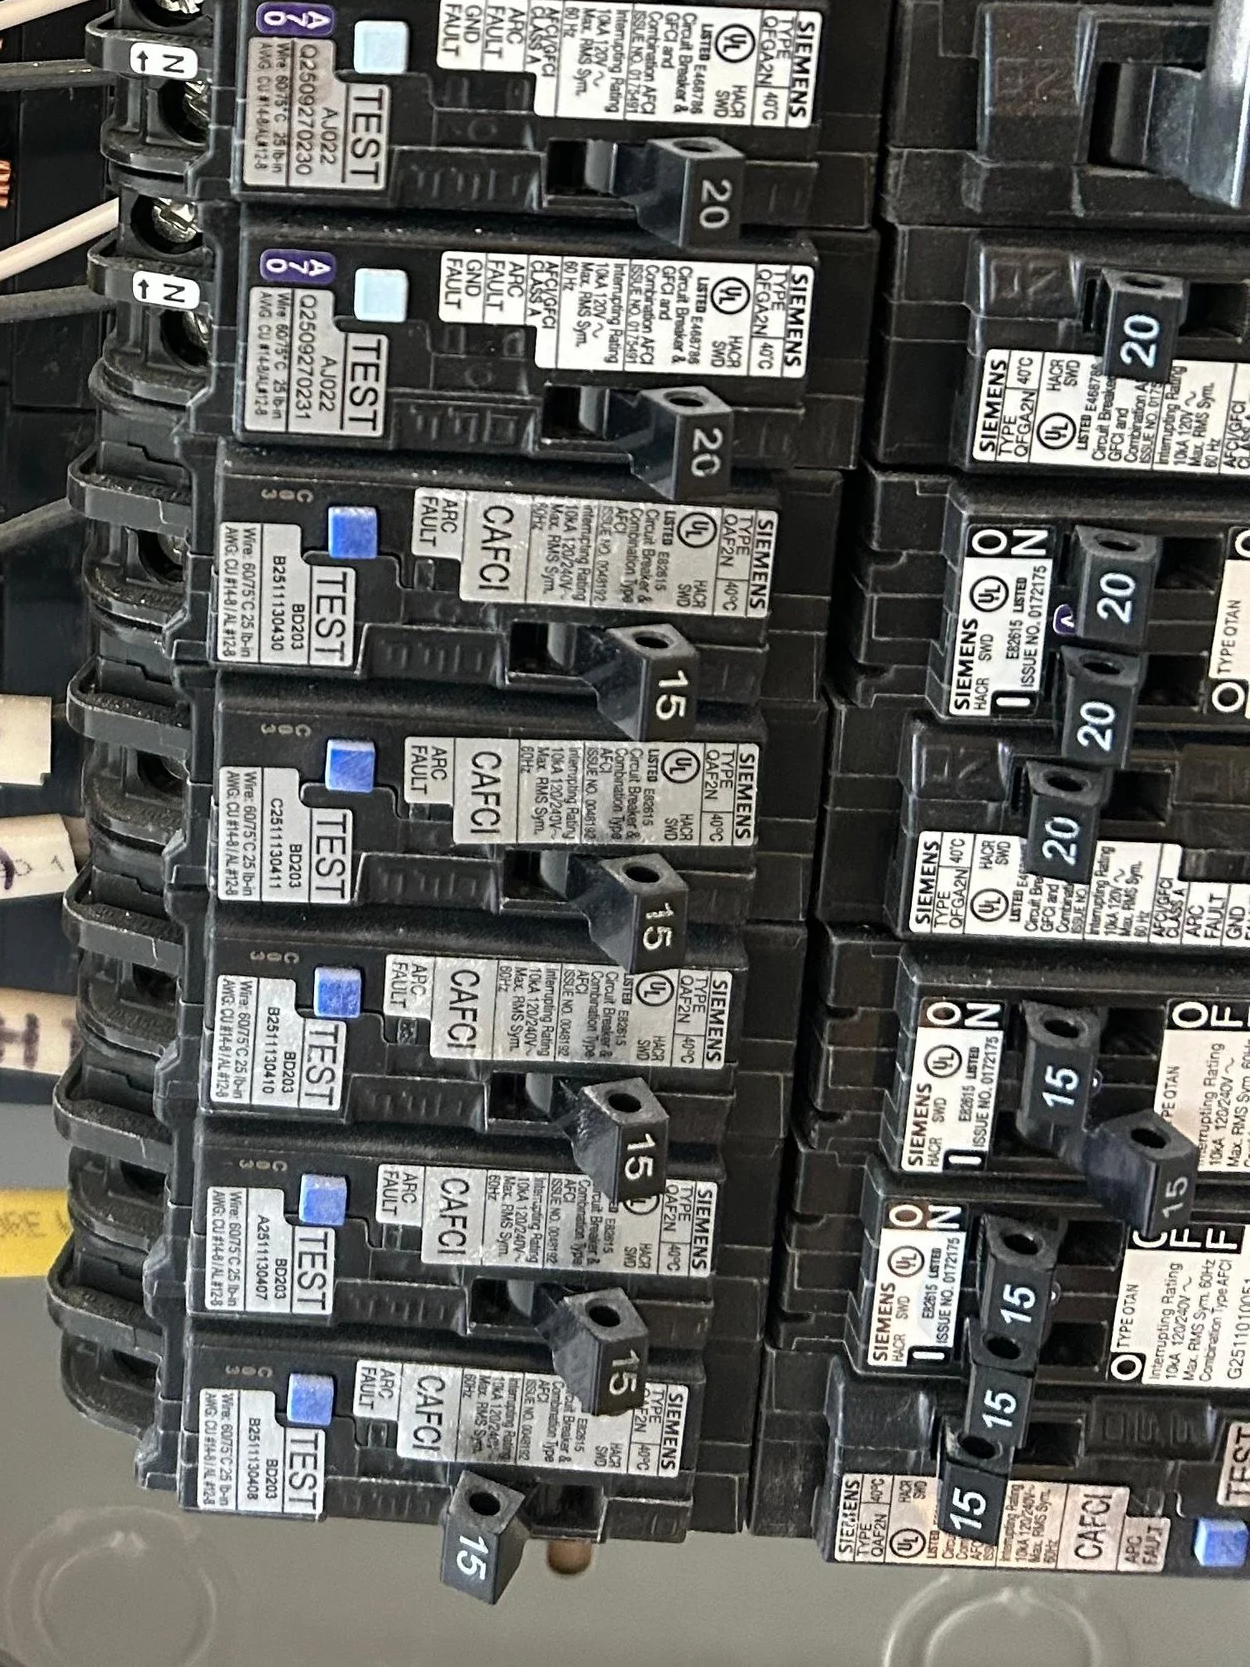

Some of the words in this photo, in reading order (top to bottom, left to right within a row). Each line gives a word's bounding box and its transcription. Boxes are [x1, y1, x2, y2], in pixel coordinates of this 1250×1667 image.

[162, 54, 184, 73] N
[789, 21, 815, 118] SIEMENS
[294, 44, 317, 176] Q2509270230
[319, 106, 338, 165] AJ022
[350, 89, 383, 183] TEST
[699, 179, 732, 229] 20
[444, 258, 461, 309] FAULT
[465, 259, 482, 296] GND
[486, 259, 505, 312] FAULT
[507, 261, 524, 297] ARC
[528, 260, 544, 304] CLASS
[562, 277, 577, 291] Hz
[563, 261, 578, 274] 60
[593, 262, 609, 289] 10kA
[629, 264, 644, 296] ISSUE
[661, 265, 676, 296] GFCI
[677, 266, 693, 305] Circuit
[771, 270, 787, 311] TYPE
[163, 284, 185, 303] N
[527, 308, 540, 318] A
[542, 261, 559, 329] AFCI/GFCI
[577, 291, 591, 317] RMS
[592, 292, 608, 319] 120V
[607, 263, 627, 325] Interrupting
[642, 265, 659, 334] Combination
[659, 298, 672, 321] and
[695, 277, 709, 313] LISTED
[752, 269, 772, 334] QFGA2N
[573, 320, 590, 348] Sym.
[672, 307, 688, 352] Breaker
[784, 273, 808, 367] SIEMENS
[1120, 314, 1160, 368] 20
[295, 294, 317, 419] Q2509270231
[605, 328, 622, 364] Rating
[640, 337, 656, 365] AFCI
[671, 355, 686, 364] &
[711, 340, 725, 368] SWD
[727, 335, 743, 368] HACR
[318, 356, 337, 412] AJ022
[349, 339, 382, 431] TEST
[979, 360, 1006, 452] SIEMENS
[691, 428, 723, 477] 20
[419, 496, 438, 546] FAULT
[442, 498, 459, 533] ARC
[242, 528, 257, 558] Wire:
[478, 505, 514, 591] CAFCI
[750, 519, 774, 610] SIEMENS
[971, 529, 1048, 556] ON
[271, 556, 286, 651] B2511130430
[1014, 578, 1027, 612] LISTED
[1028, 566, 1047, 618] 0172175
[1096, 572, 1136, 624] 20
[241, 614, 255, 629] 25
[291, 604, 305, 650] BD203
[315, 571, 347, 662] TEST
[240, 633, 255, 657] lb-in
[954, 619, 979, 710] SIEMENS
[1021, 650, 1039, 687] ISSUE
[655, 670, 689, 721] 15
[1076, 701, 1116, 751] 20
[471, 751, 501, 834] CAFCI
[705, 749, 720, 800] QAF2N
[719, 750, 734, 789] TYPE
[735, 753, 755, 839] SIEMENS
[269, 798, 283, 889] C2511130411
[315, 813, 347, 898] TEST
[1042, 817, 1079, 865] 20
[289, 844, 302, 889] BD203
[916, 841, 938, 924] SIEMENS
[642, 903, 674, 951] 15
[447, 969, 480, 1049] CAFCI
[705, 980, 728, 1062] SIEMENS
[926, 1002, 1000, 1027] ON
[262, 1007, 280, 1094] B2511130410
[281, 1051, 296, 1094] BD203
[305, 1025, 339, 1106] TEST
[1041, 1065, 1078, 1106] 15
[908, 1084, 933, 1166] SIEMENS
[624, 1133, 655, 1180] 15
[437, 1178, 470, 1255] CAFCI
[888, 1203, 961, 1228] ON
[1163, 1176, 1188, 1218] 15
[692, 1190, 713, 1270] SIEMENS
[255, 1215, 269, 1301] A2511130407
[274, 1258, 287, 1300] BD203
[297, 1232, 329, 1310] TEST
[872, 1283, 894, 1361] SIEMENS
[1001, 1285, 1035, 1324] 15
[609, 1350, 640, 1395] 15
[412, 1375, 446, 1452] CAFCI
[661, 1393, 683, 1470] SIEMENS
[982, 1390, 1016, 1429] 15
[246, 1418, 260, 1500] B2511130408
[265, 1459, 278, 1499] BD203
[288, 1433, 319, 1510] TEST
[950, 1489, 986, 1531] 15
[1074, 1494, 1114, 1561] CAFCI
[456, 1536, 489, 1580] 15
